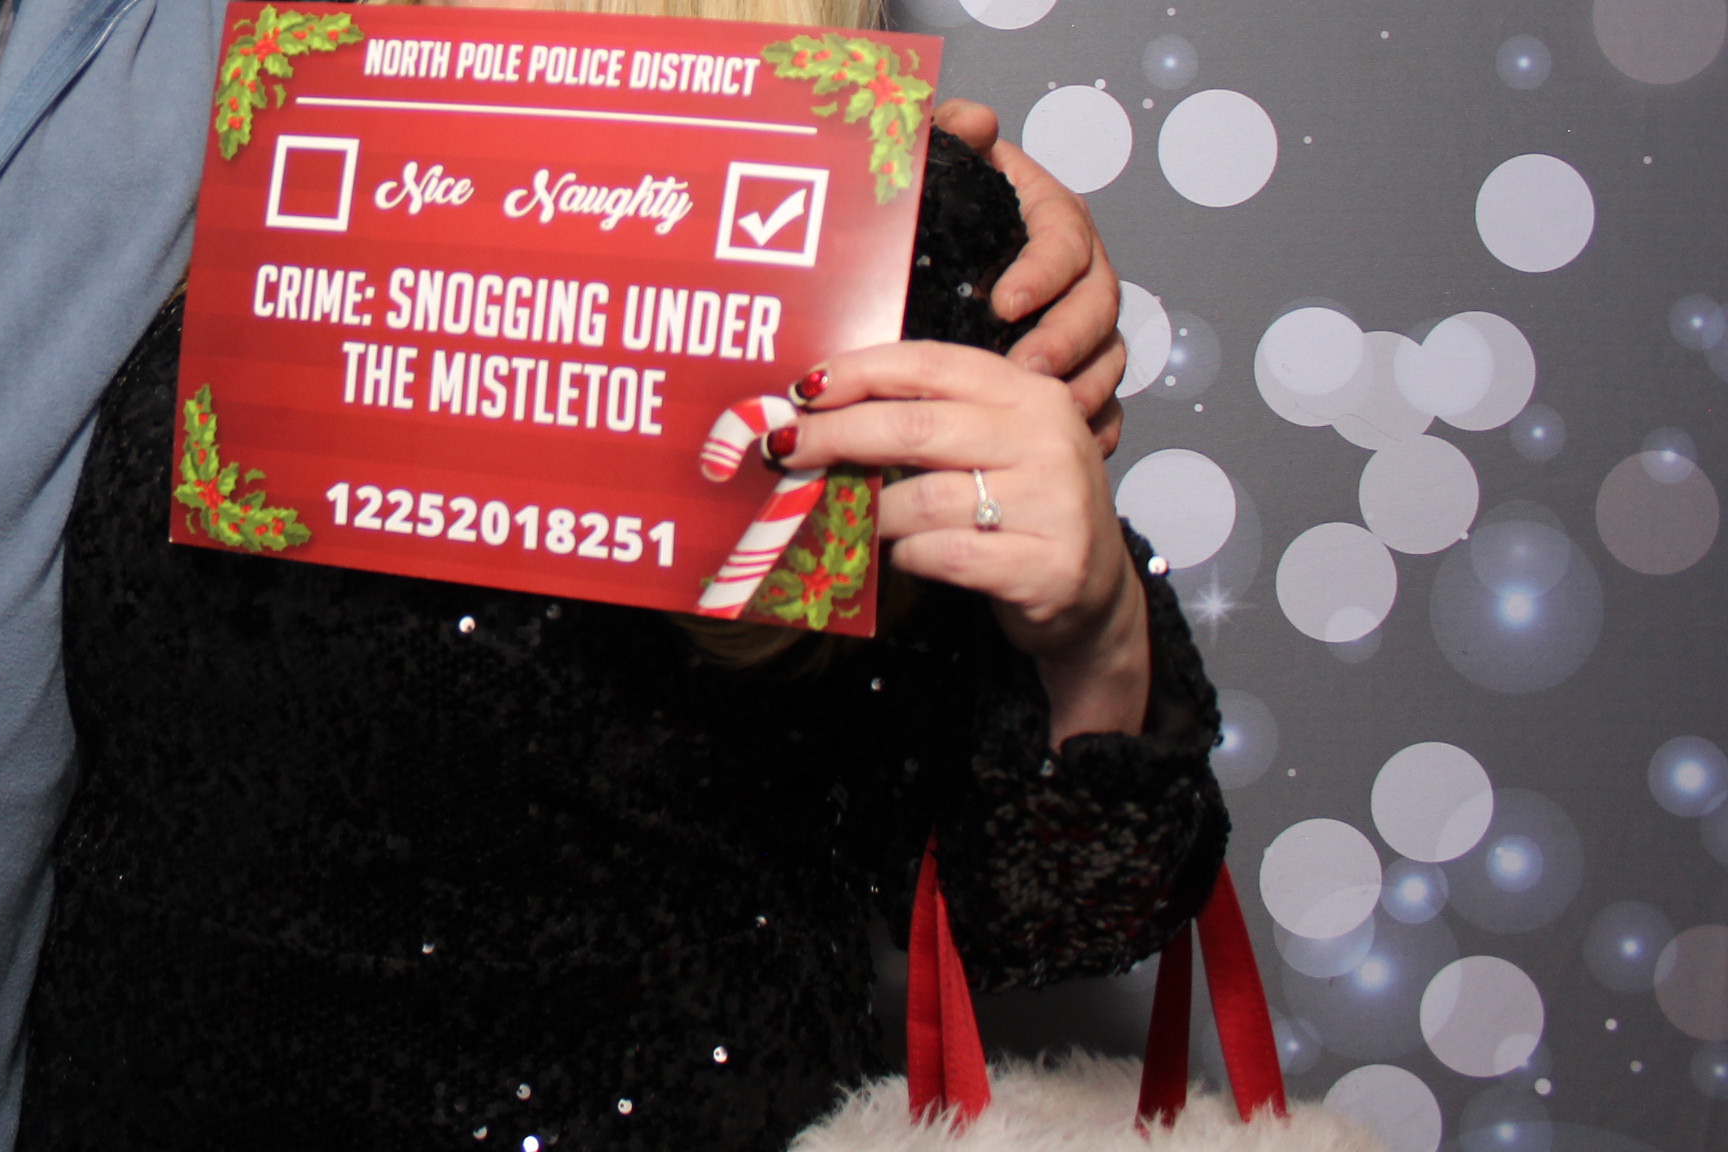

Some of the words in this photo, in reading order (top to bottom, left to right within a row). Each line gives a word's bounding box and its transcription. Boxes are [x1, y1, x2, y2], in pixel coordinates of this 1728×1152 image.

[364, 38, 452, 79] NORTH
[455, 41, 524, 83] POLE
[526, 44, 626, 88] POLICE
[628, 50, 762, 97] DISTRICT
[374, 161, 475, 215] Nice
[503, 168, 694, 235] Naughty
[253, 264, 376, 328] CRIME:
[385, 267, 610, 347] SNOGGING
[622, 285, 782, 363] UNDER
[342, 341, 418, 410] THE
[428, 349, 666, 436] MISTLETOE
[326, 482, 676, 567] 12252018251
